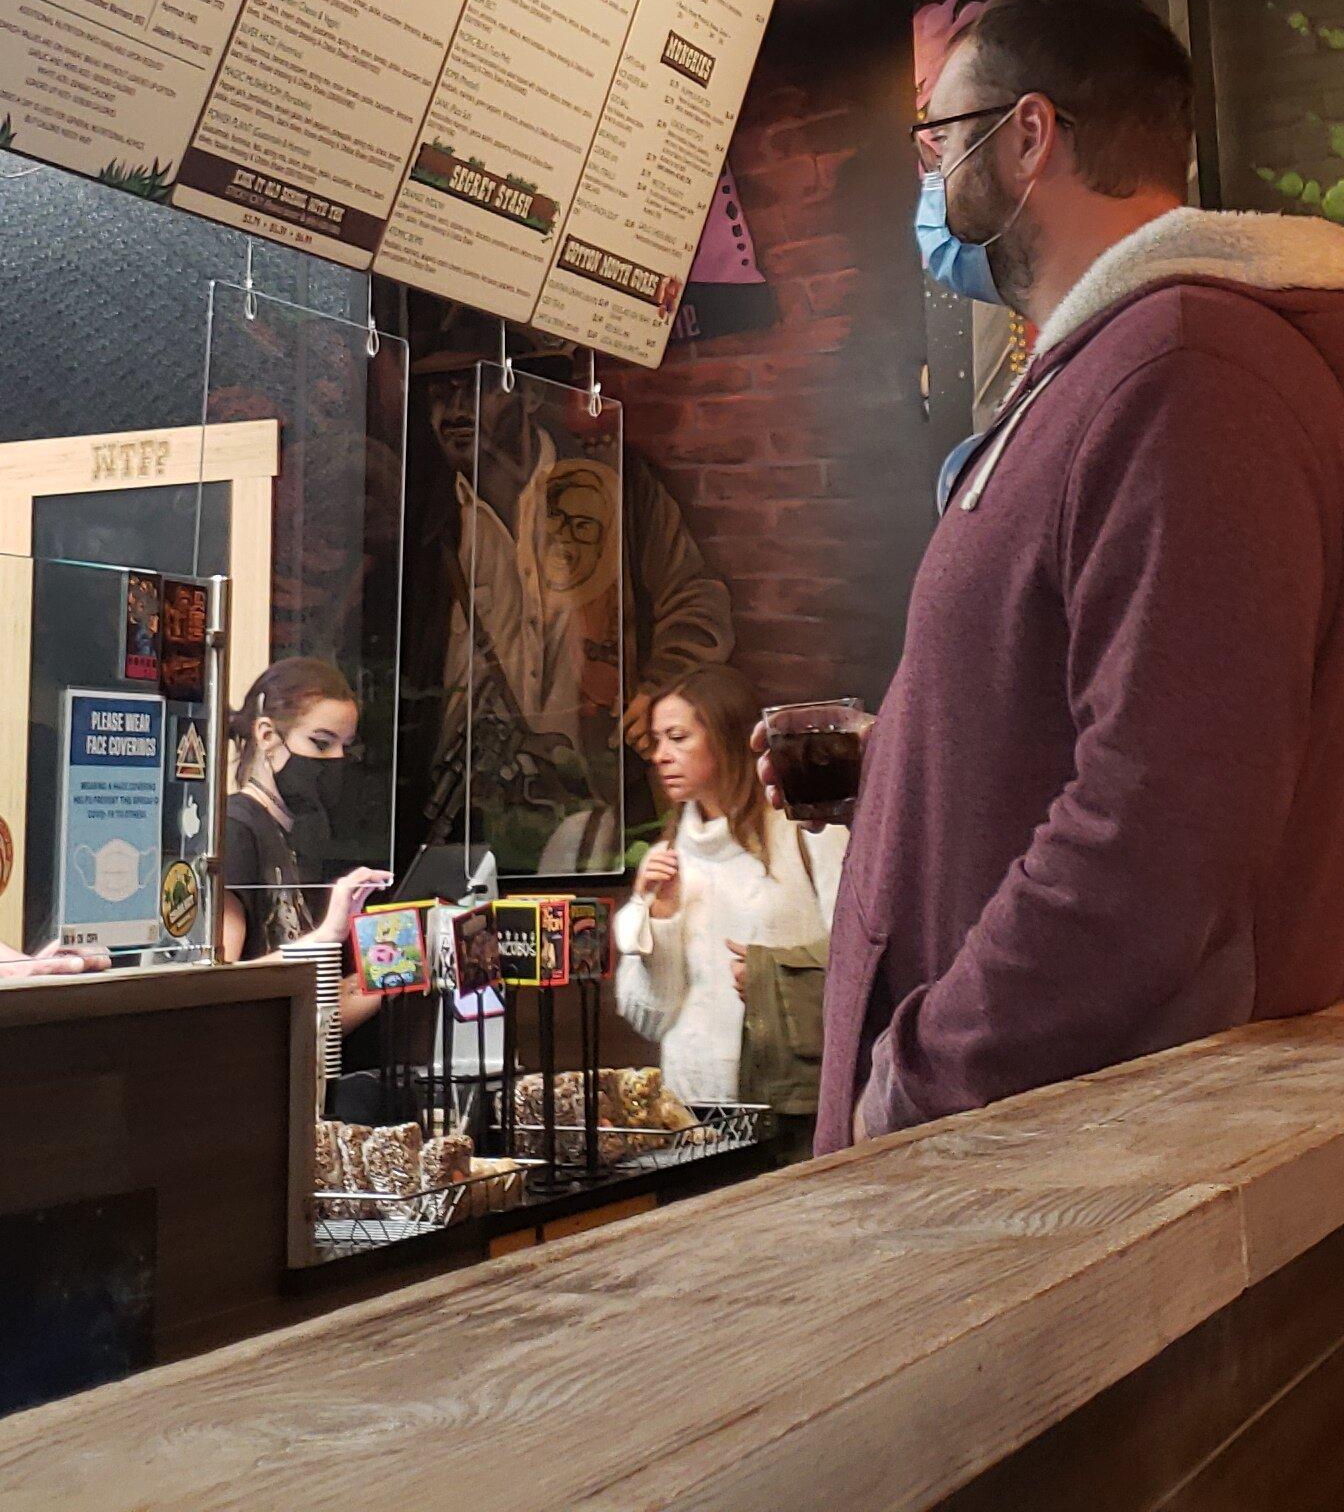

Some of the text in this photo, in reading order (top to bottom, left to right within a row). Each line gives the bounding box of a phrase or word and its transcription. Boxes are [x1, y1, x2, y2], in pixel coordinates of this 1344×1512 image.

[448, 164, 533, 219] SECRET STASH
[91, 710, 151, 732] PLEASE WEAR
[86, 735, 156, 756] FACE COVERINGS
